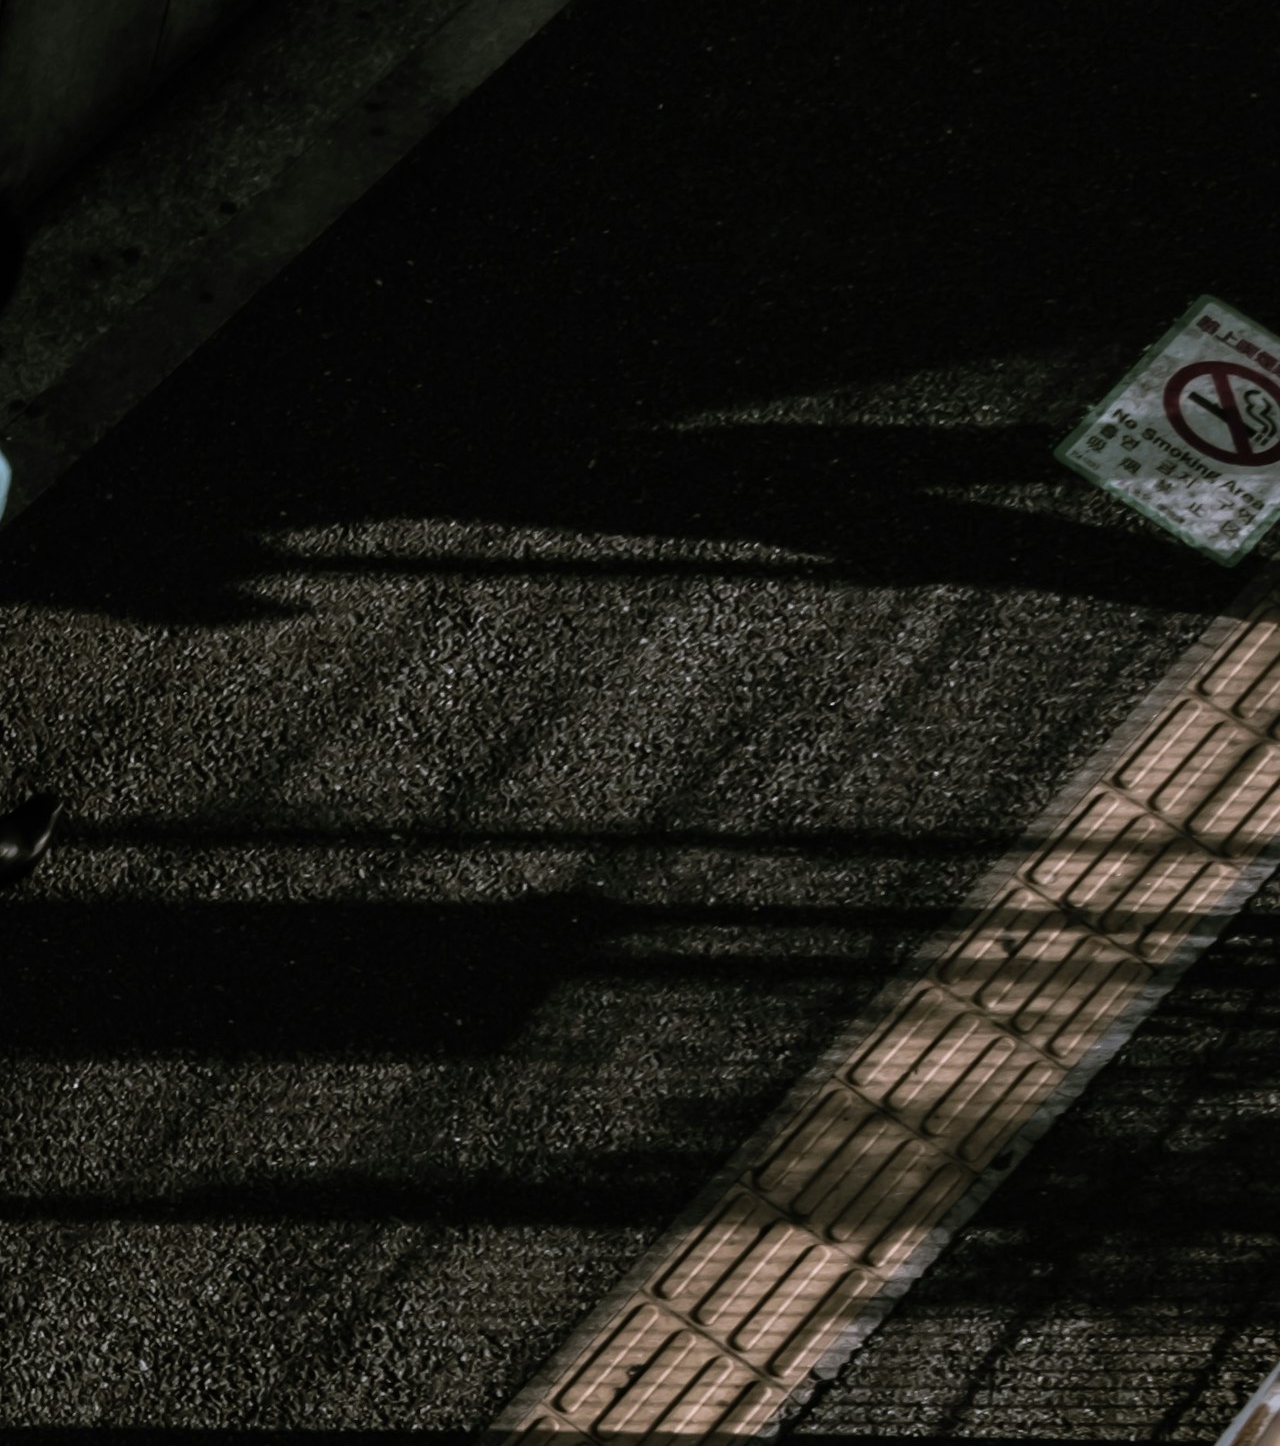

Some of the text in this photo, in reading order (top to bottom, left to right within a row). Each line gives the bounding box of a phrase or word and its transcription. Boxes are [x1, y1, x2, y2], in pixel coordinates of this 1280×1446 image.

[1112, 408, 1138, 430] No
[1142, 428, 1222, 483] Smoking
[1221, 479, 1265, 511] Area
